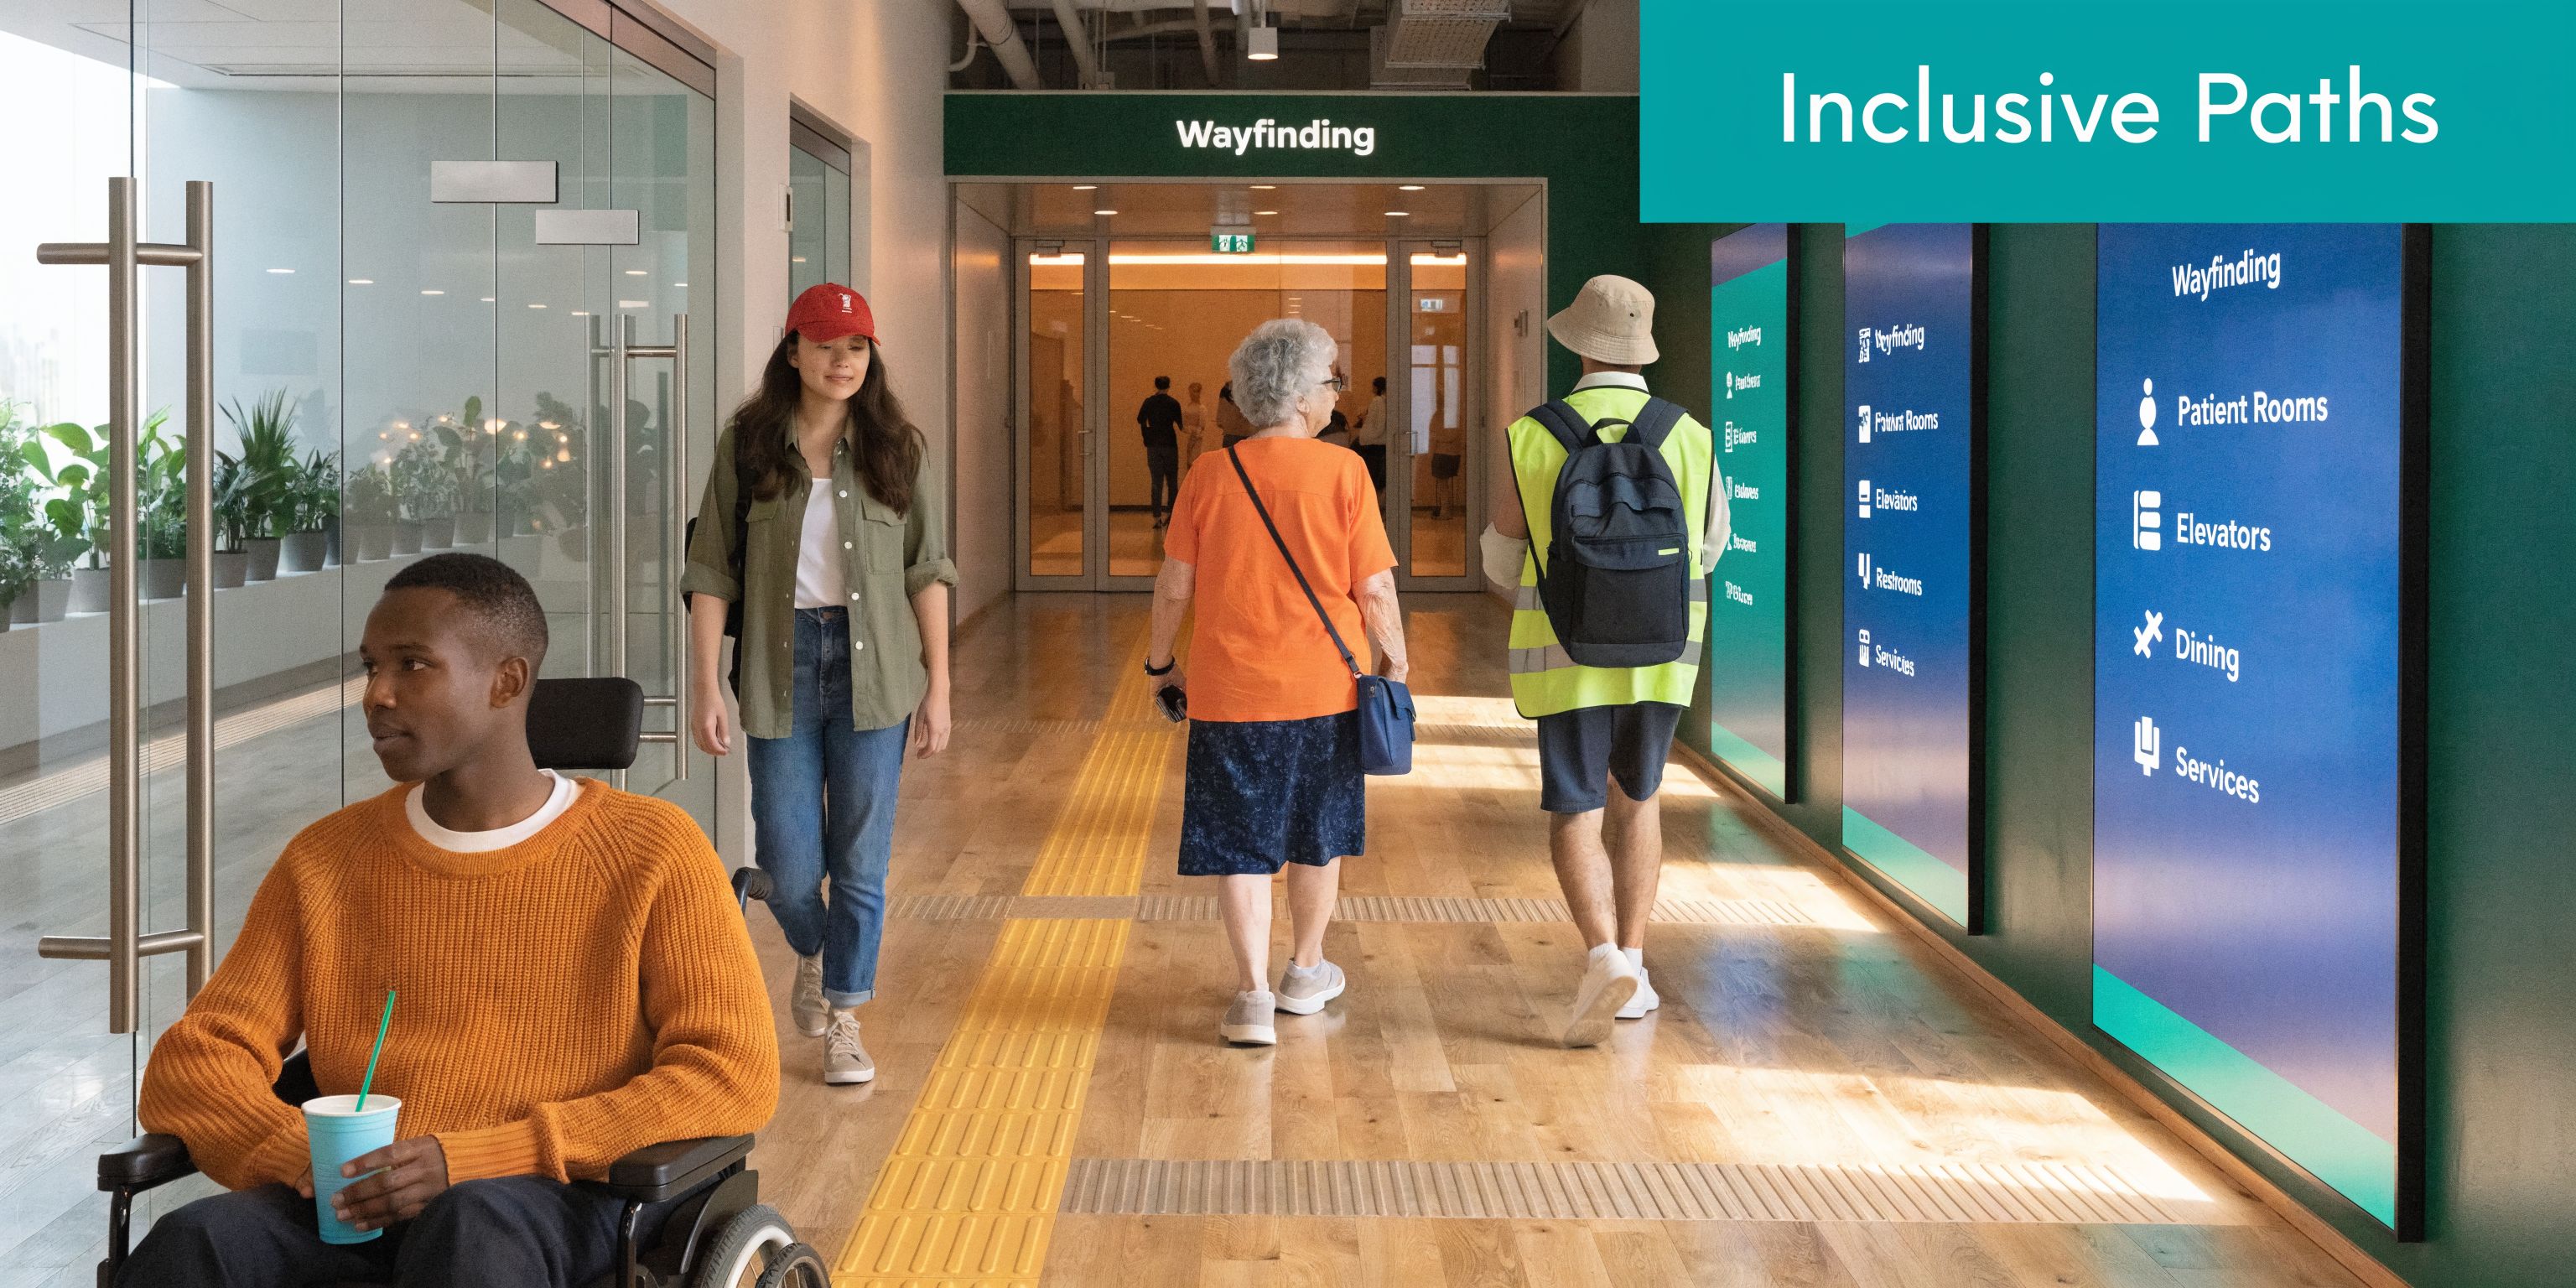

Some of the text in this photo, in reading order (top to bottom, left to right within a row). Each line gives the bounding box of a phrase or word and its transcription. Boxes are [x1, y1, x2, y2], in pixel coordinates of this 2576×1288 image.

[1176, 119, 1374, 155] Wayfinding
[2173, 249, 2280, 301] Wayfinding
[1906, 410, 1939, 431] Rooms
[2179, 392, 2329, 426] Patient Rooms
[2178, 513, 2272, 551] Elevators
[2177, 628, 2239, 682] Dining
[2176, 746, 2259, 803] Services
